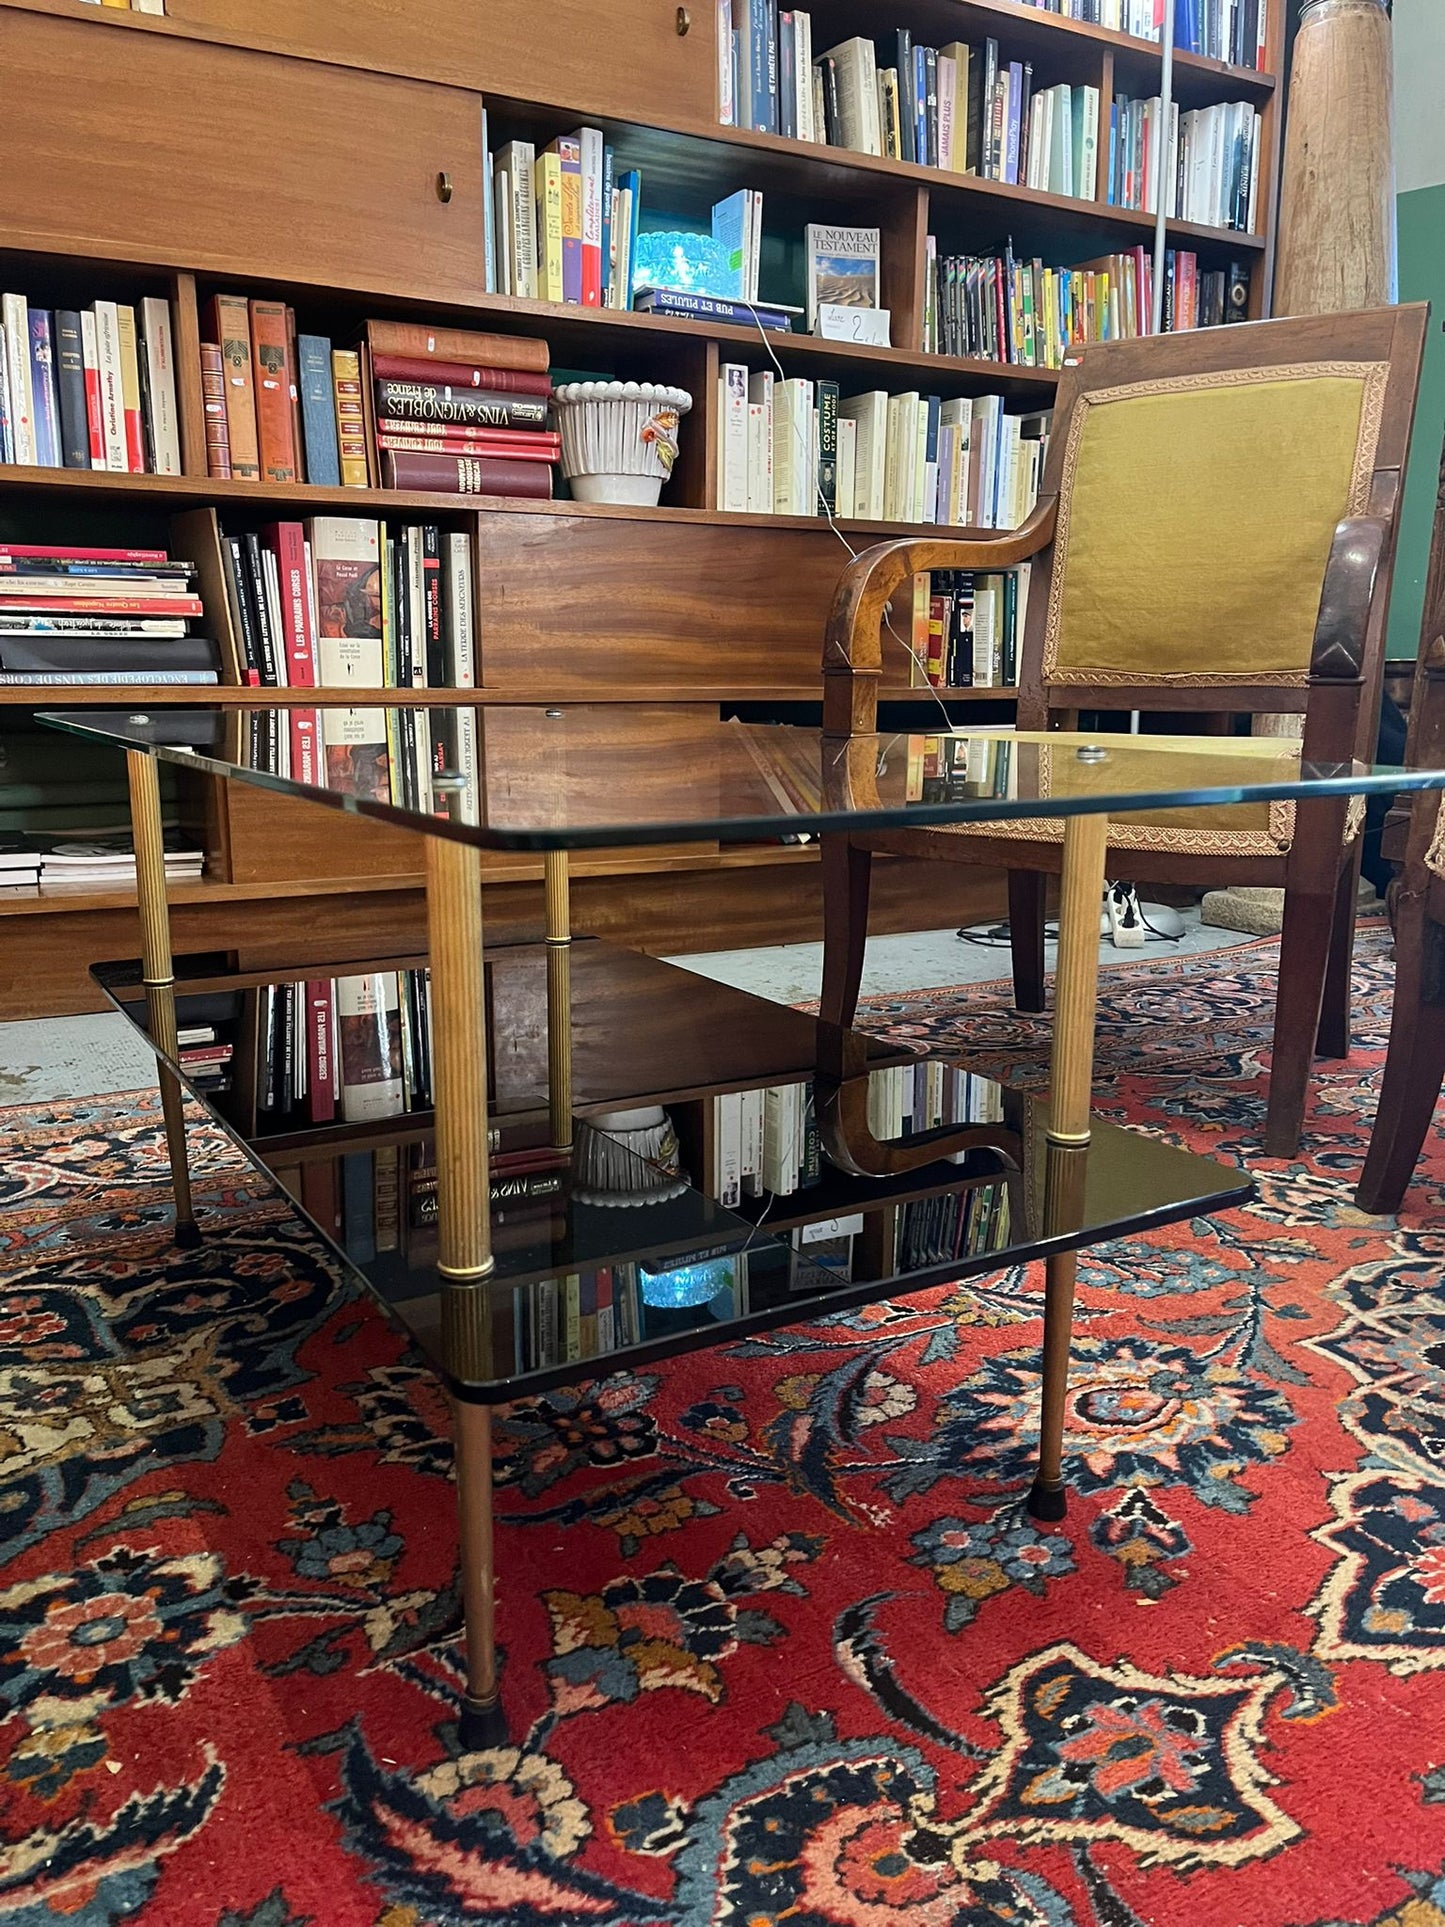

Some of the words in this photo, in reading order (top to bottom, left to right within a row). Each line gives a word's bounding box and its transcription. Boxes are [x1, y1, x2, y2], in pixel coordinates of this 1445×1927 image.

[768, 84, 776, 94] NE
[943, 100, 951, 123] PLUS
[941, 124, 949, 157] JAMAIS
[1007, 118, 1018, 164] PhonePlay
[605, 153, 613, 181] bassins
[605, 182, 612, 191] de
[813, 230, 822, 239] LE
[825, 230, 878, 243] NOUVEAU
[813, 238, 878, 254] TESTAMENT
[660, 293, 698, 309] PILULES
[701, 301, 713, 311] ET
[715, 303, 734, 315] PUB
[106, 371, 116, 402] Arnothy
[387, 383, 422, 399] France
[423, 386, 437, 400] de
[387, 396, 467, 421] VIGNOBLES
[477, 405, 510, 425] VINS
[109, 403, 118, 436] Christine
[822, 393, 831, 452] COSTUME
[831, 418, 837, 428] LA
[426, 423, 447, 436] TOUT
[424, 439, 446, 453] TOUT
[457, 458, 466, 493] NOUVEAU
[464, 459, 473, 494] LAROUSSE
[472, 461, 481, 493] MÉDICAL
[255, 578, 263, 595] CORSE
[290, 569, 301, 597] CORSES
[106, 601, 128, 609] Quatre
[258, 602, 265, 610] DE
[293, 598, 304, 633] PARRAINS
[432, 606, 440, 640] PARRAINS
[260, 611, 268, 637] LITTORAL
[295, 634, 305, 647] LES
[264, 645, 272, 662] TOURS
[460, 653, 468, 663] LA
[36, 675, 53, 685] DE
[56, 674, 85, 685] VINS
[87, 674, 107, 684] DES
[107, 674, 189, 684] ENCYCLOPÉDIE
